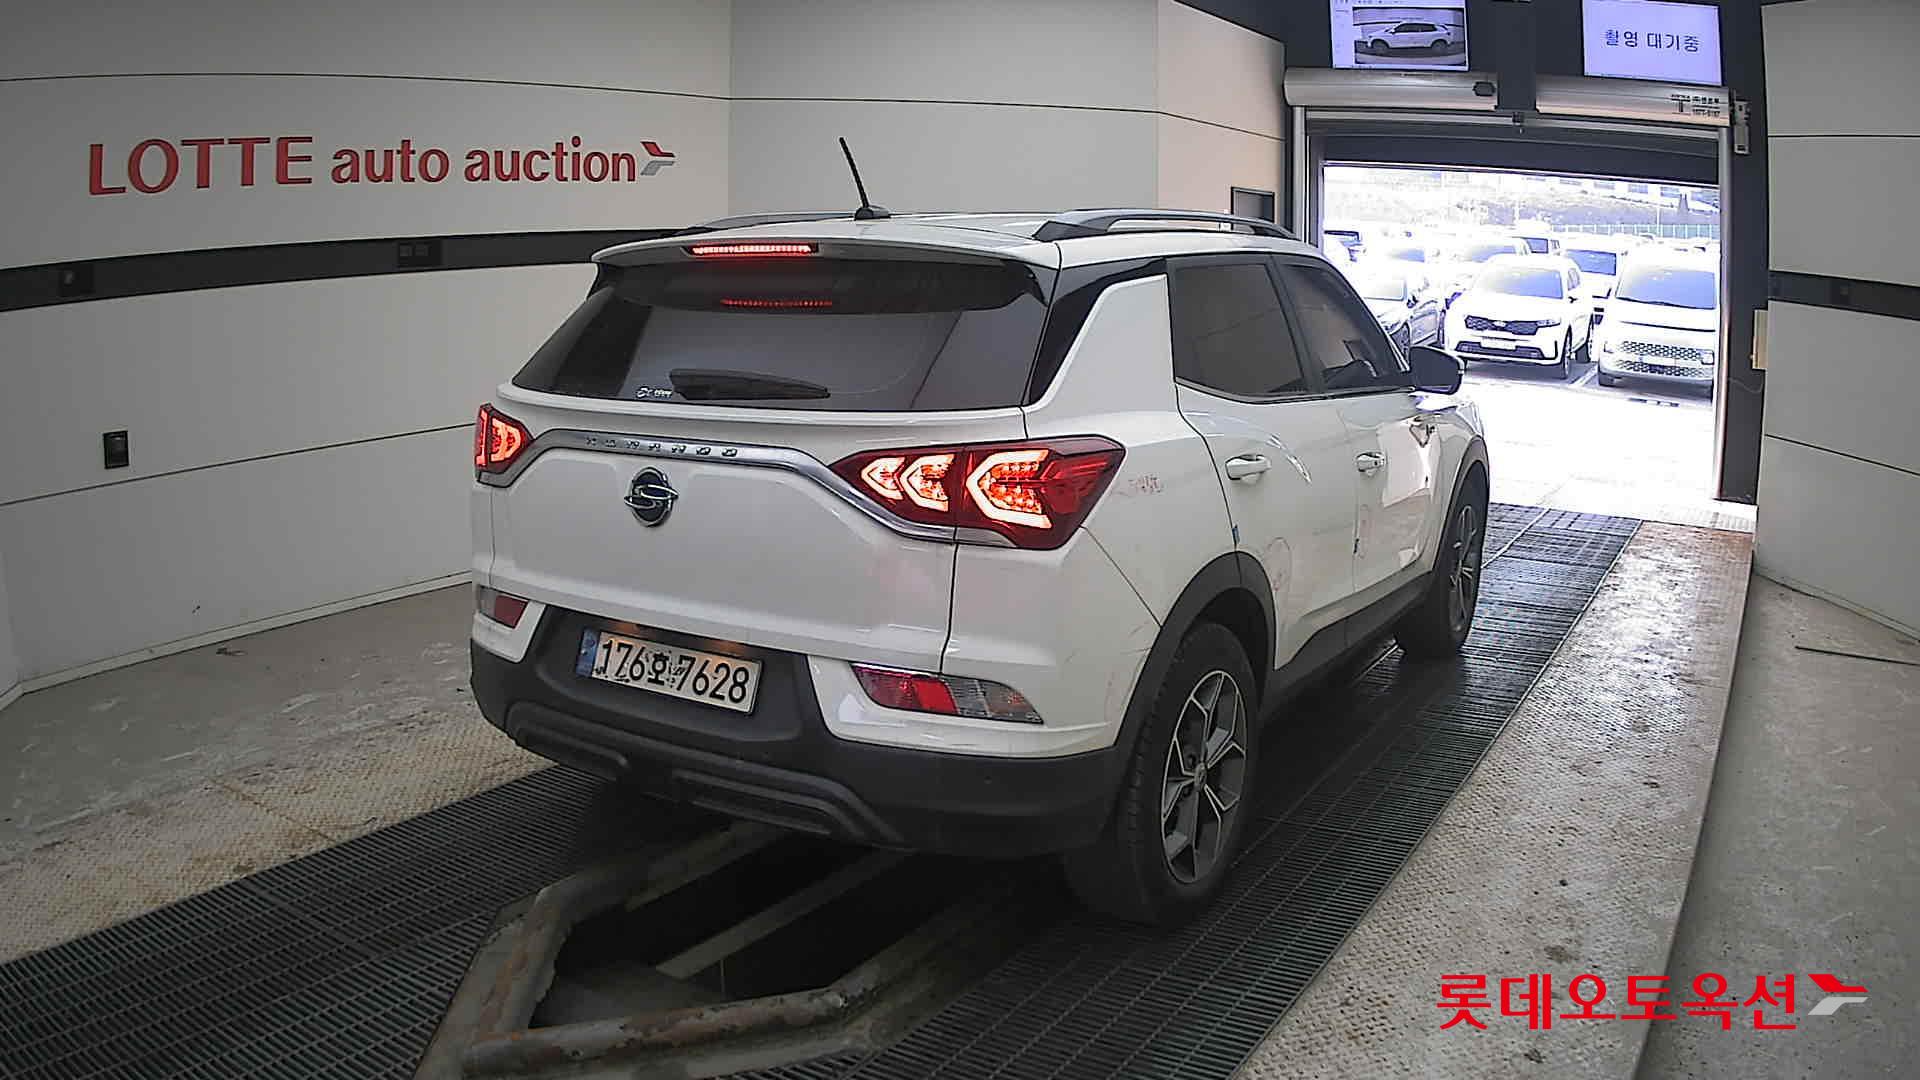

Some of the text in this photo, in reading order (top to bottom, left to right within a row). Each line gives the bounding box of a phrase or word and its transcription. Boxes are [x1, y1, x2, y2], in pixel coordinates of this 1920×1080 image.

[1647, 32, 1700, 53] 대기중
[88, 136, 637, 195] LOTTE auto auction
